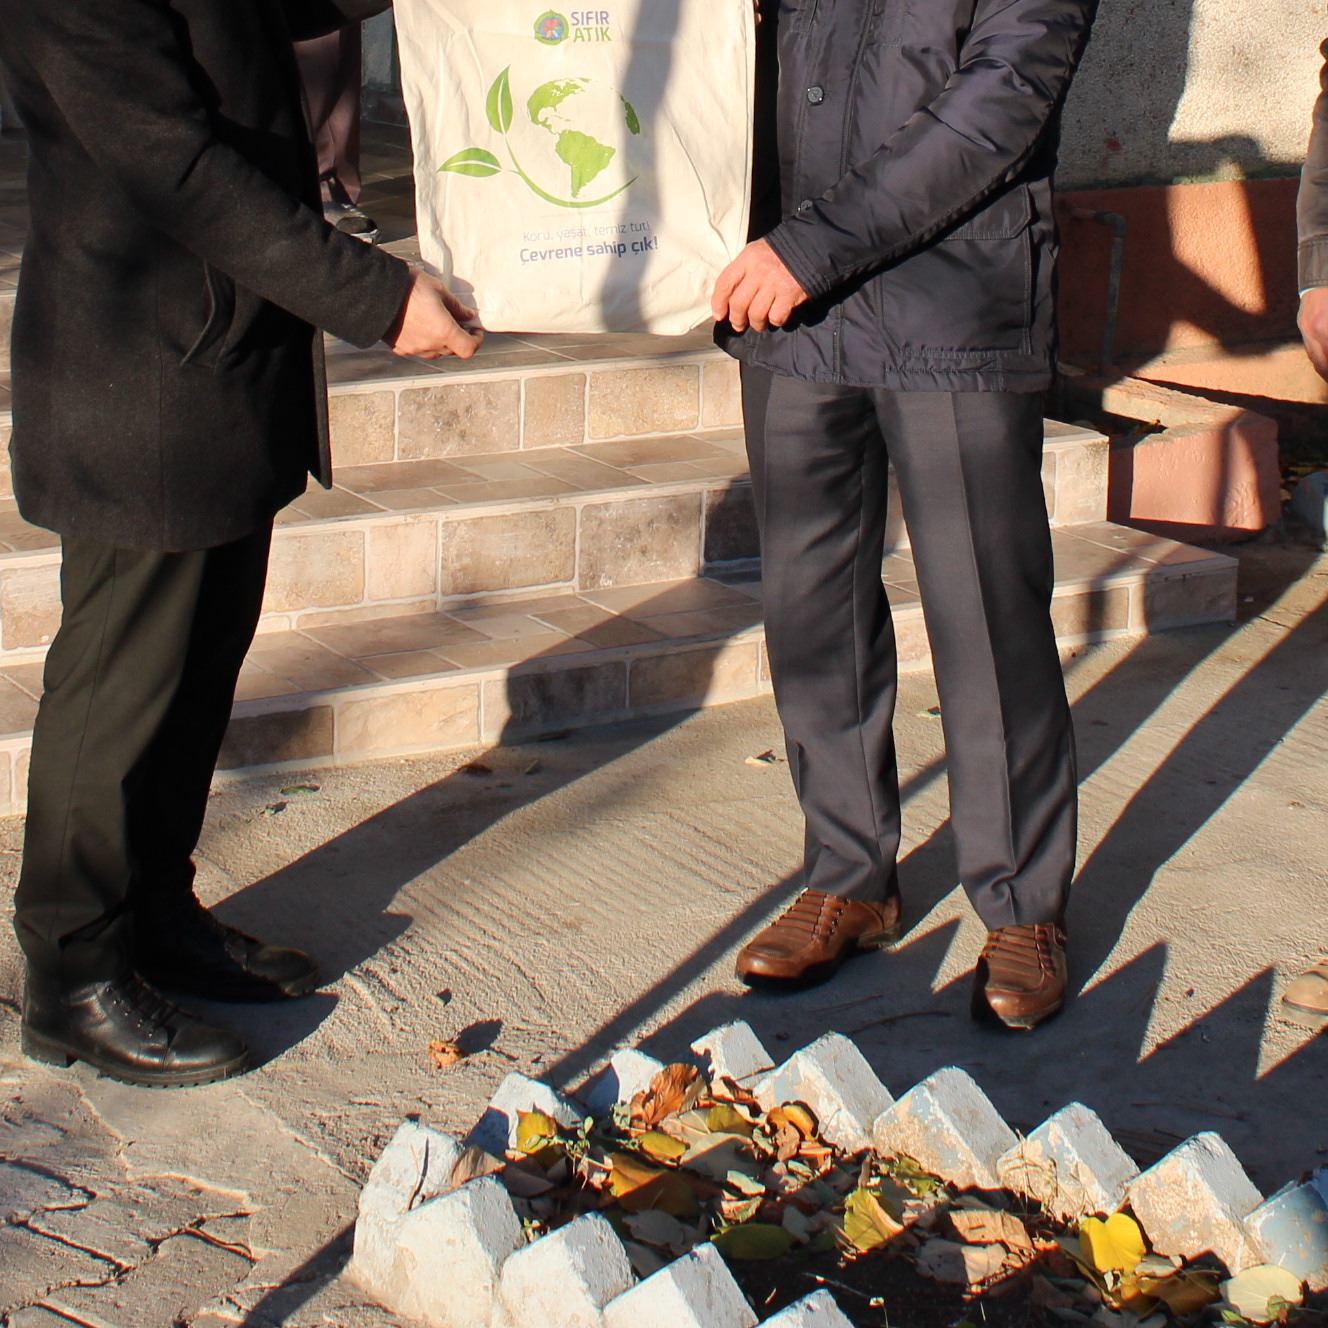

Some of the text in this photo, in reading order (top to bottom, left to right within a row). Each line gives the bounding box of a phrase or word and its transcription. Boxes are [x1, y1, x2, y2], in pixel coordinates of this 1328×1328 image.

[571, 11, 610, 26] SIFIR
[573, 27, 612, 43] ATIK
[594, 222, 626, 238] temiz
[519, 236, 659, 265] Çevrene sahip çık!
